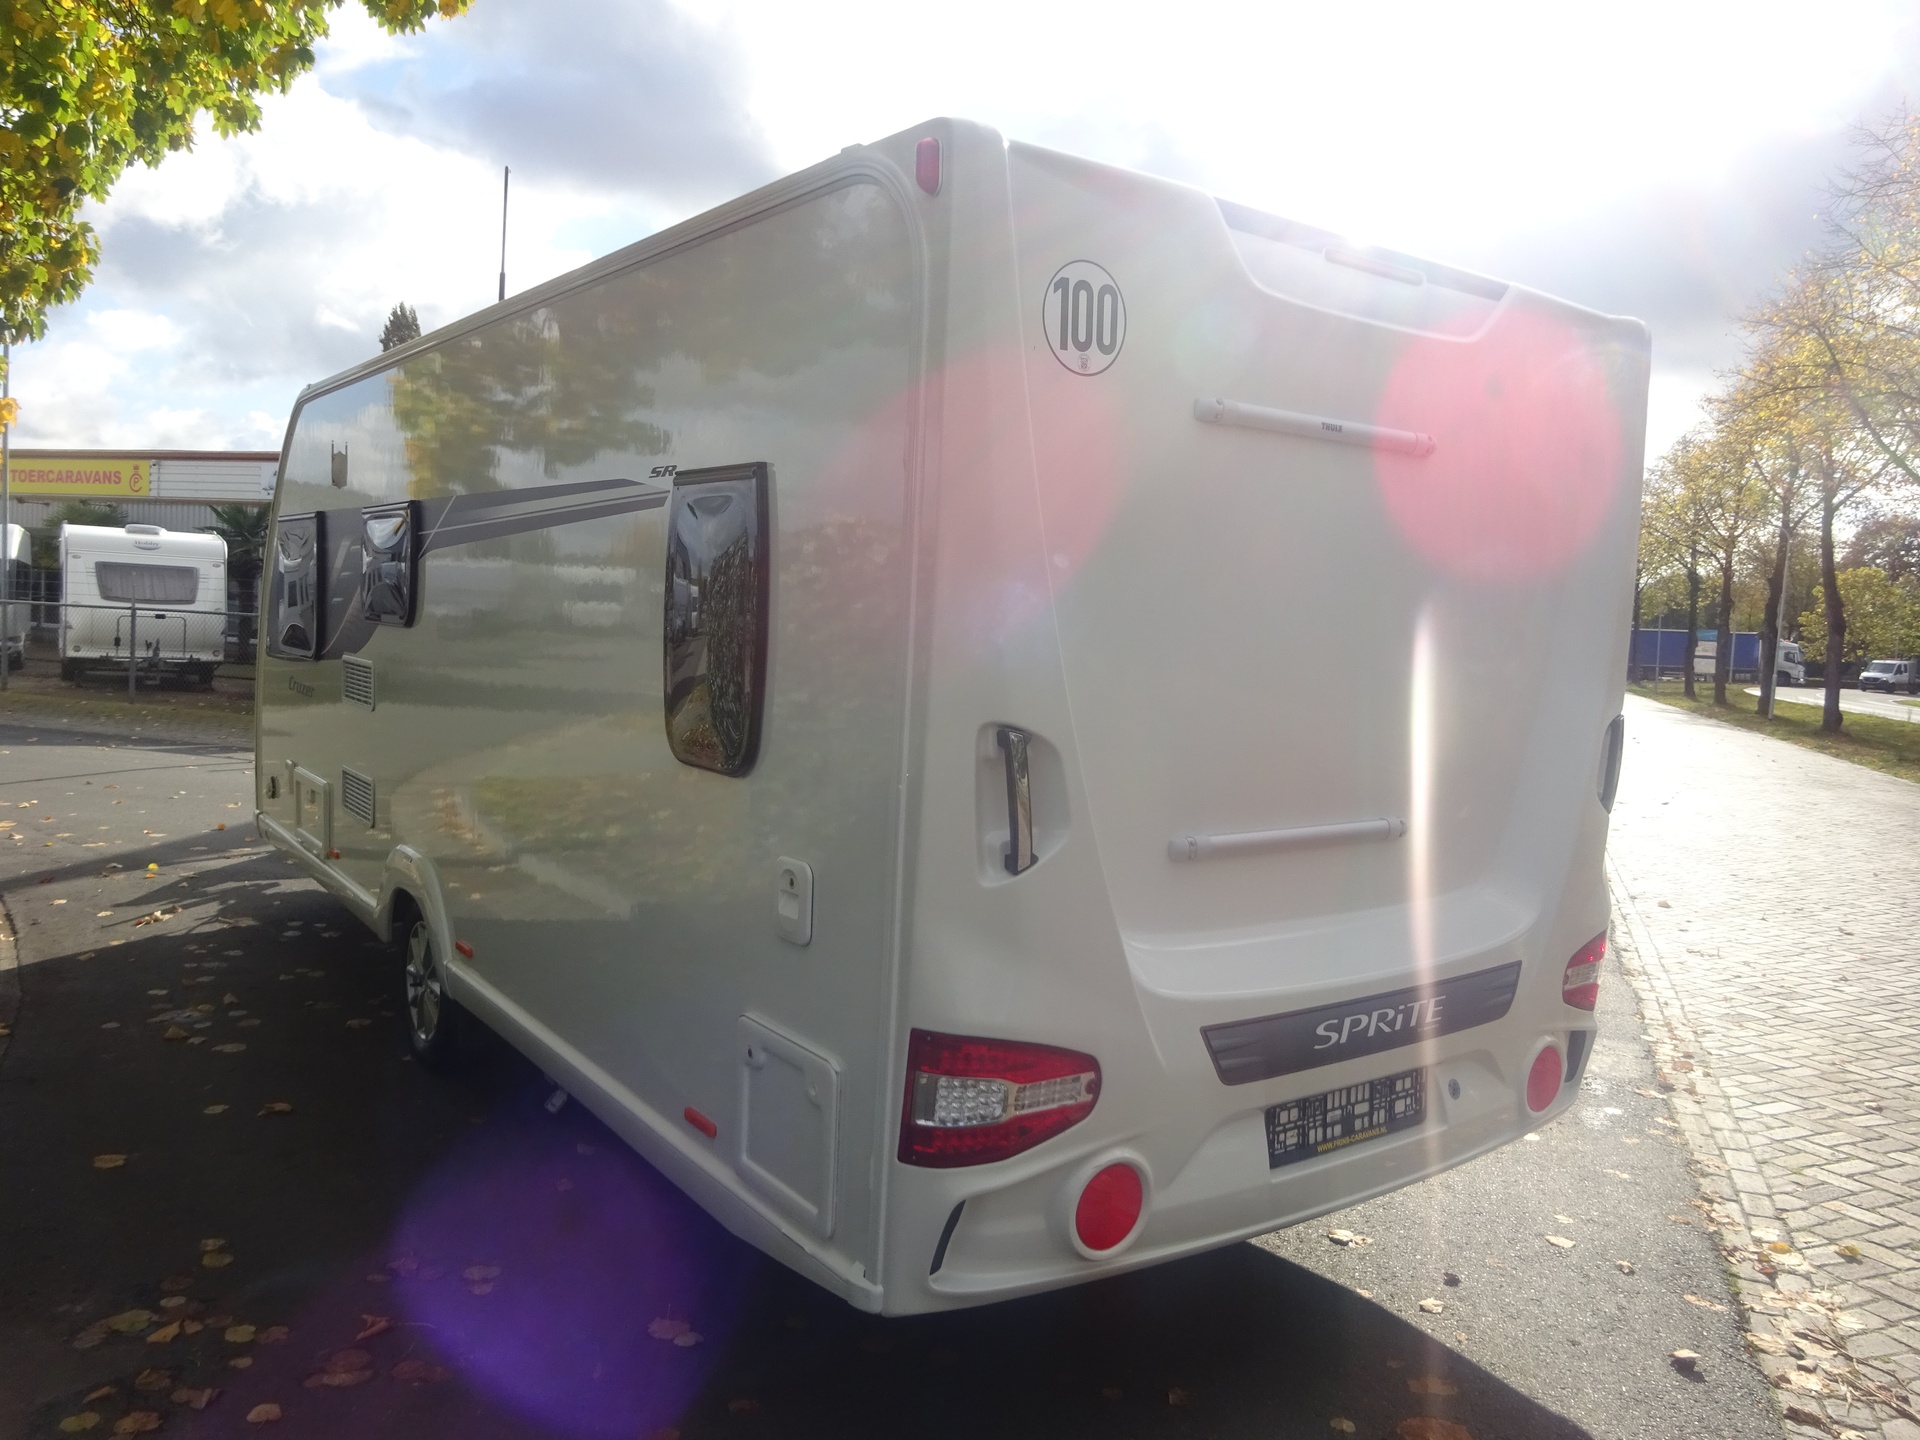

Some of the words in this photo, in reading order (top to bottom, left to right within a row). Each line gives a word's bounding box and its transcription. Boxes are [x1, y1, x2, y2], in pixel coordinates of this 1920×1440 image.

[1053, 276, 1118, 355] 100
[10, 469, 122, 485] TOERCARAVANS
[648, 464, 678, 479] SR
